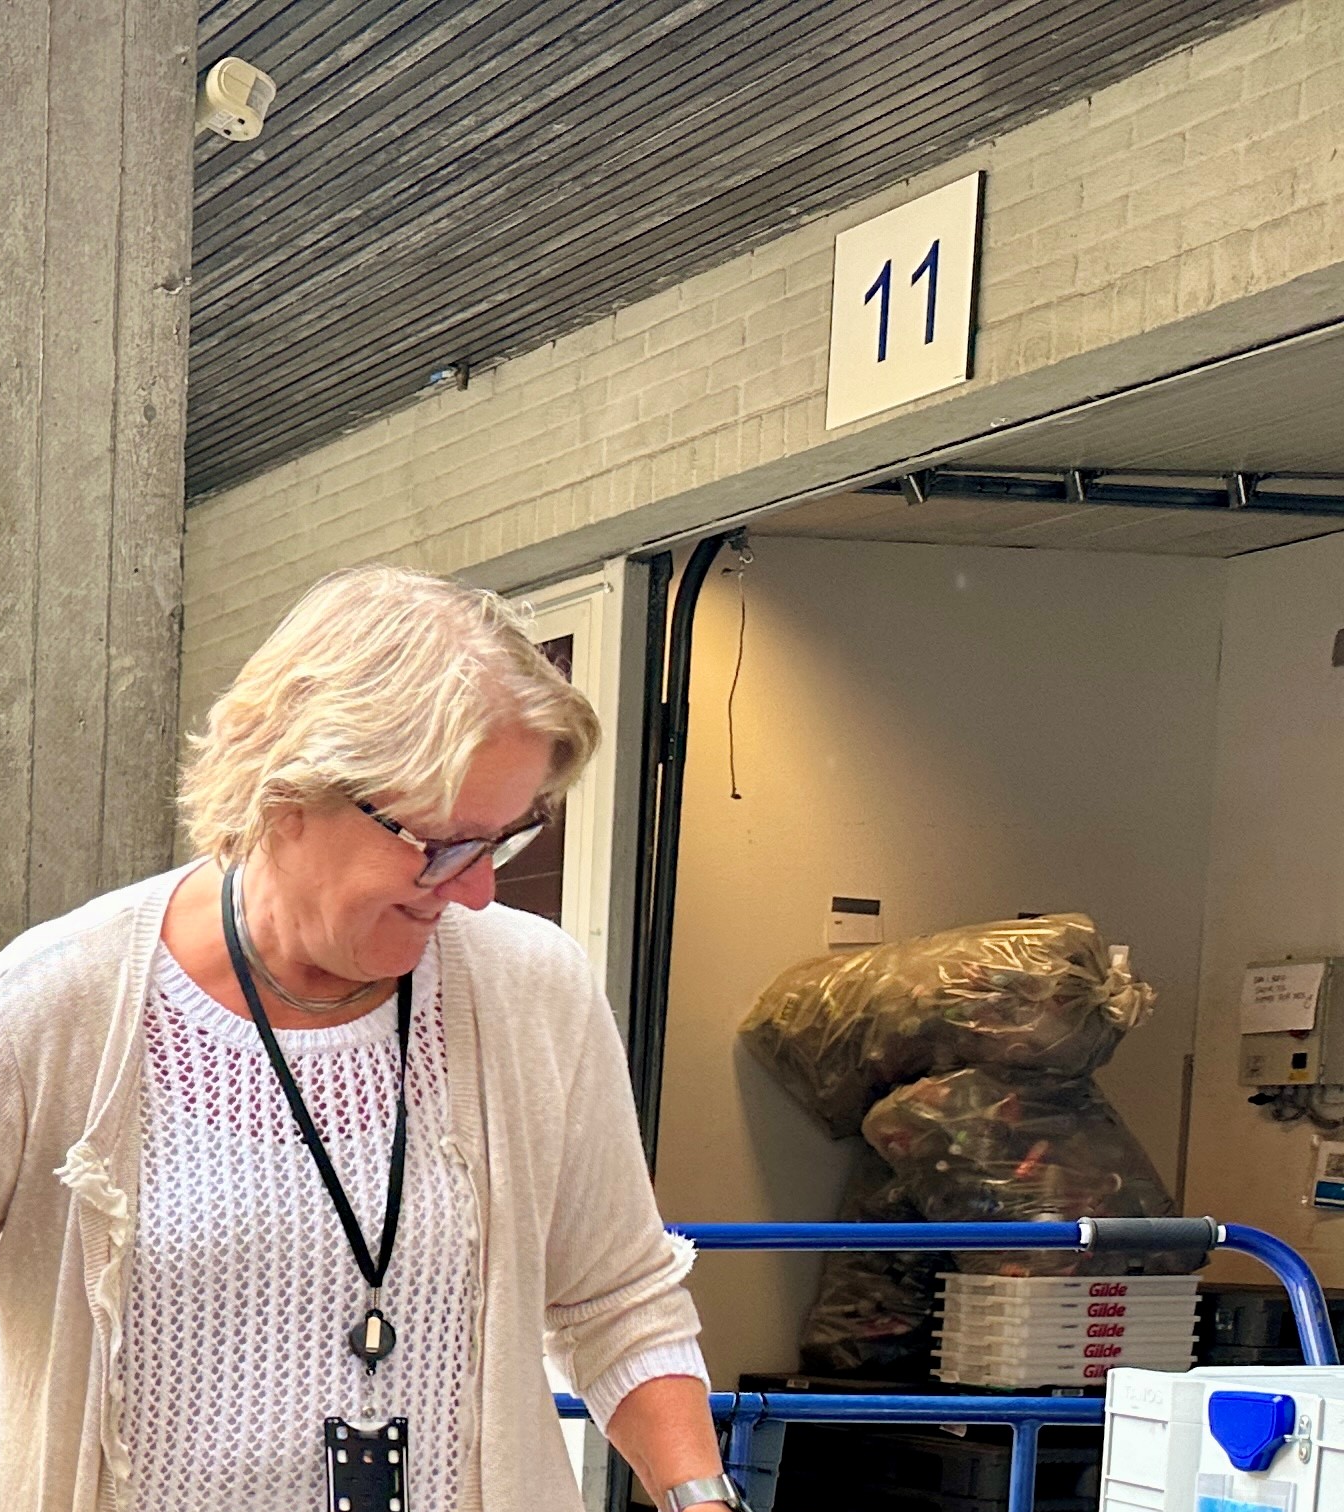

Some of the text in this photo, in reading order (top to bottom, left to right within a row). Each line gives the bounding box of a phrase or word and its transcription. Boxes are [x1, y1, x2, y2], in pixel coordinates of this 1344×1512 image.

[864, 239, 940, 363] 11
[1089, 1282, 1128, 1297] Gilde
[1087, 1303, 1126, 1317] Gilde
[1086, 1324, 1125, 1338] Gilde
[1083, 1344, 1122, 1358] Gilde
[1083, 1364, 1110, 1378] Gil
